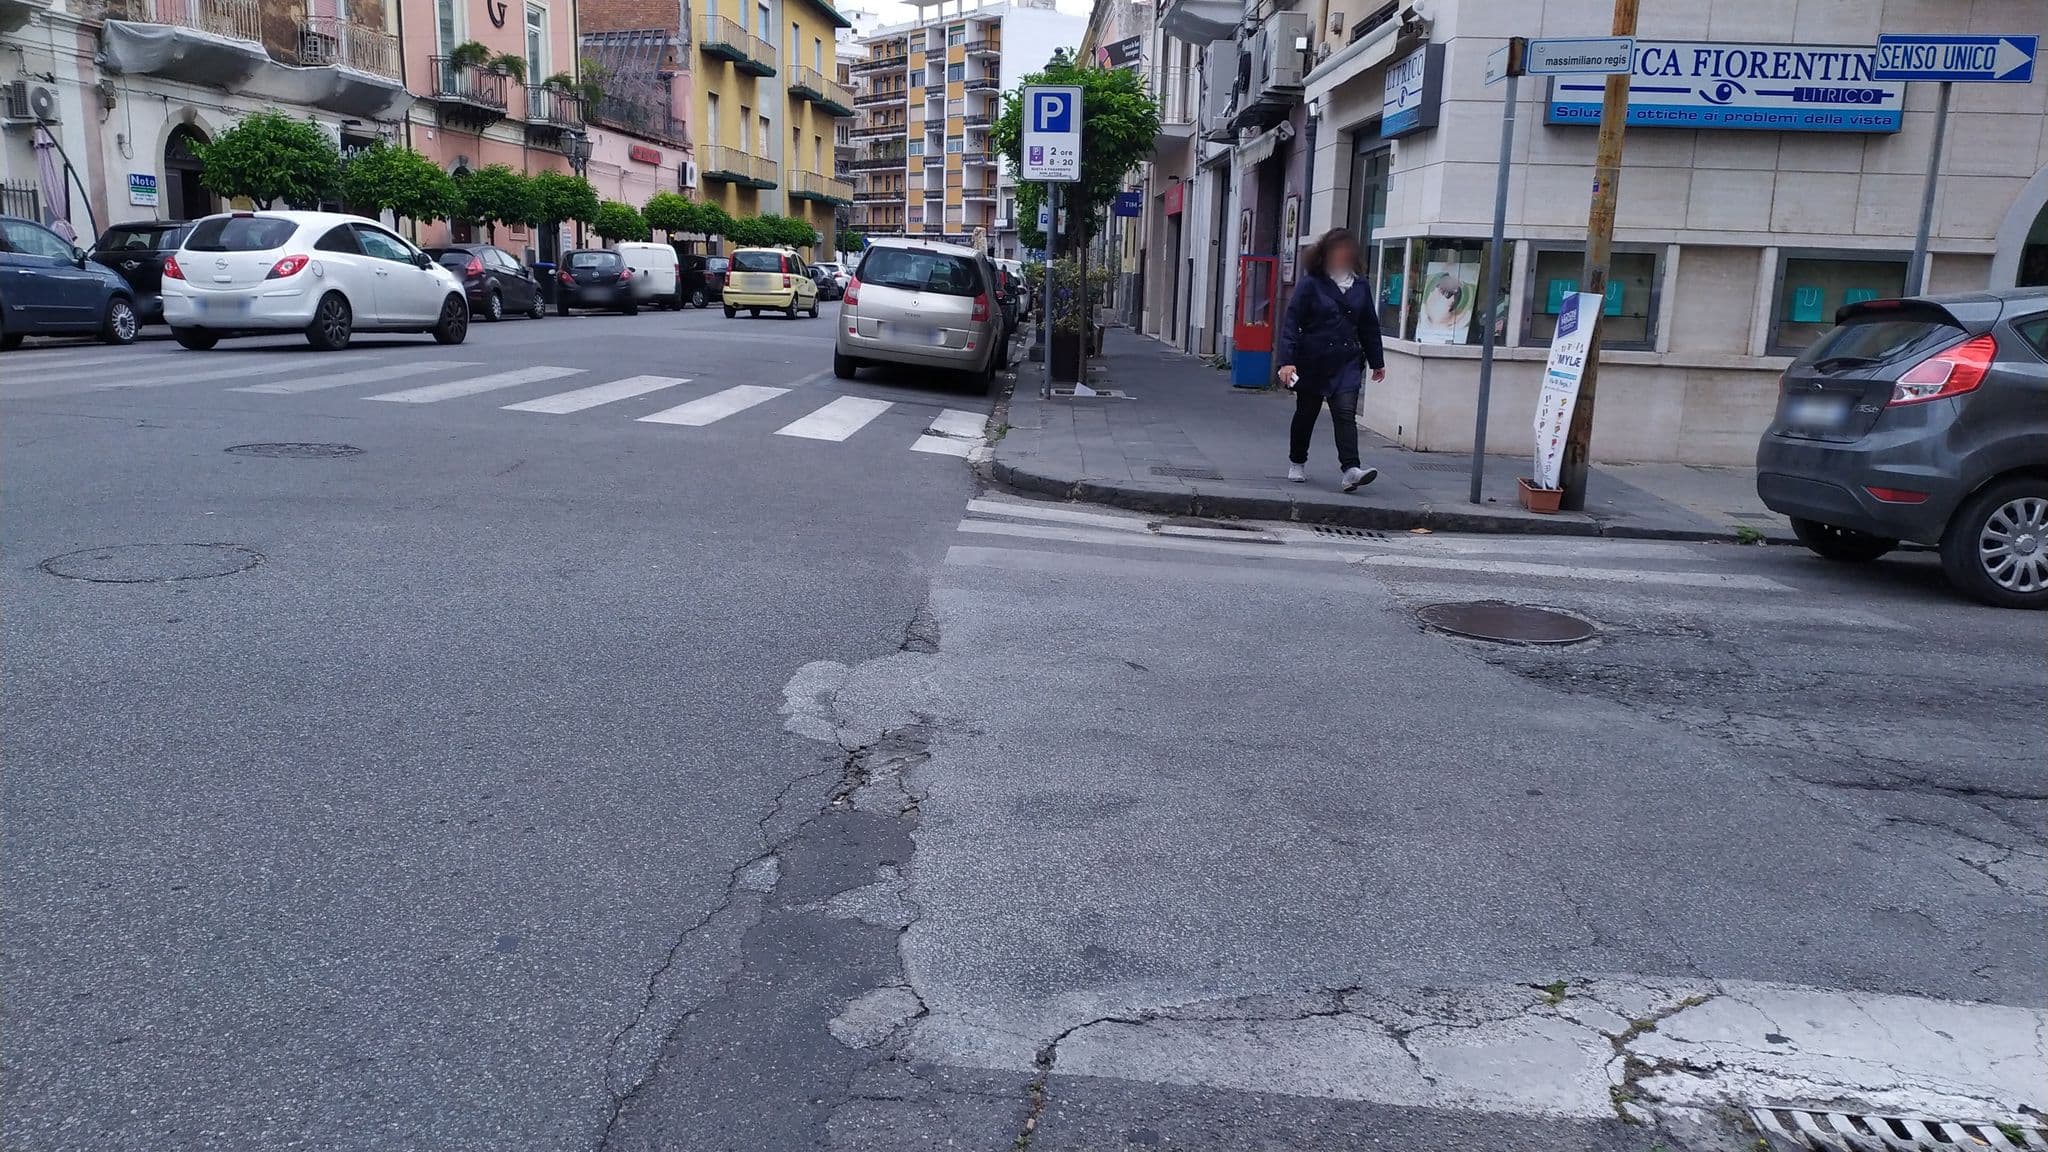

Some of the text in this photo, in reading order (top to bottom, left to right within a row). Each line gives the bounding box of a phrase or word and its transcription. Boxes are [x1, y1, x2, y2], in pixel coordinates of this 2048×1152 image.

[1545, 54, 1627, 67] massimiliano regis
[1632, 48, 1877, 82] ICA FIORENTIN
[1879, 45, 1996, 70] SENSO UNICO
[1386, 54, 1424, 90] LITRICO
[1802, 88, 1874, 104] LITRICO
[1041, 96, 1063, 129] P
[1556, 106, 1892, 126] Soluzi ottiche ai problemi della vista
[1050, 147, 1057, 156] 2
[131, 175, 155, 186] Noto
